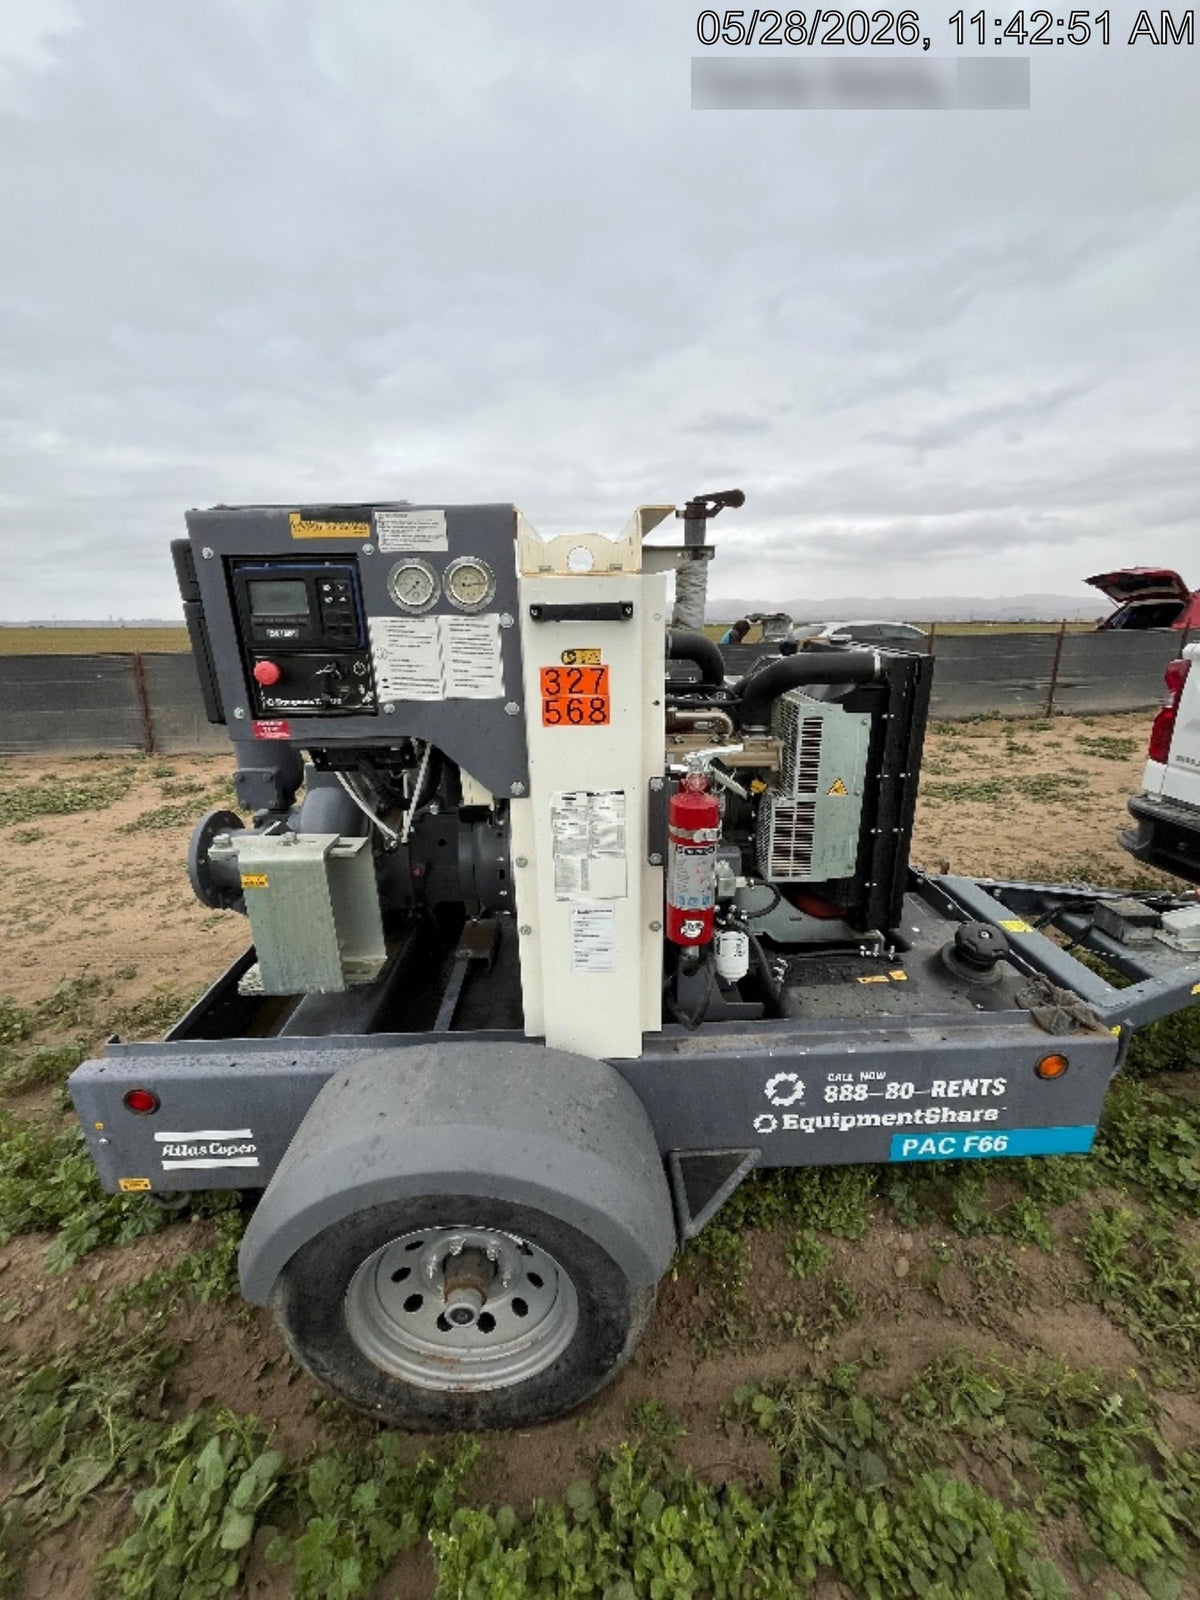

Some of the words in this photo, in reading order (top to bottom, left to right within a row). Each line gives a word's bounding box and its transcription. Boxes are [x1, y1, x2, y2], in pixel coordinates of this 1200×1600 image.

[545, 667, 605, 696] 327
[545, 697, 607, 725] 568
[827, 1072, 854, 1083] CALL
[860, 1070, 887, 1081] NOW
[824, 1077, 1007, 1103] 888-80-RENTS
[781, 1106, 999, 1133] EquipmentShare
[161, 1143, 207, 1157] Atlas
[902, 1136, 956, 1156] PAC
[963, 1135, 1009, 1153] F66
